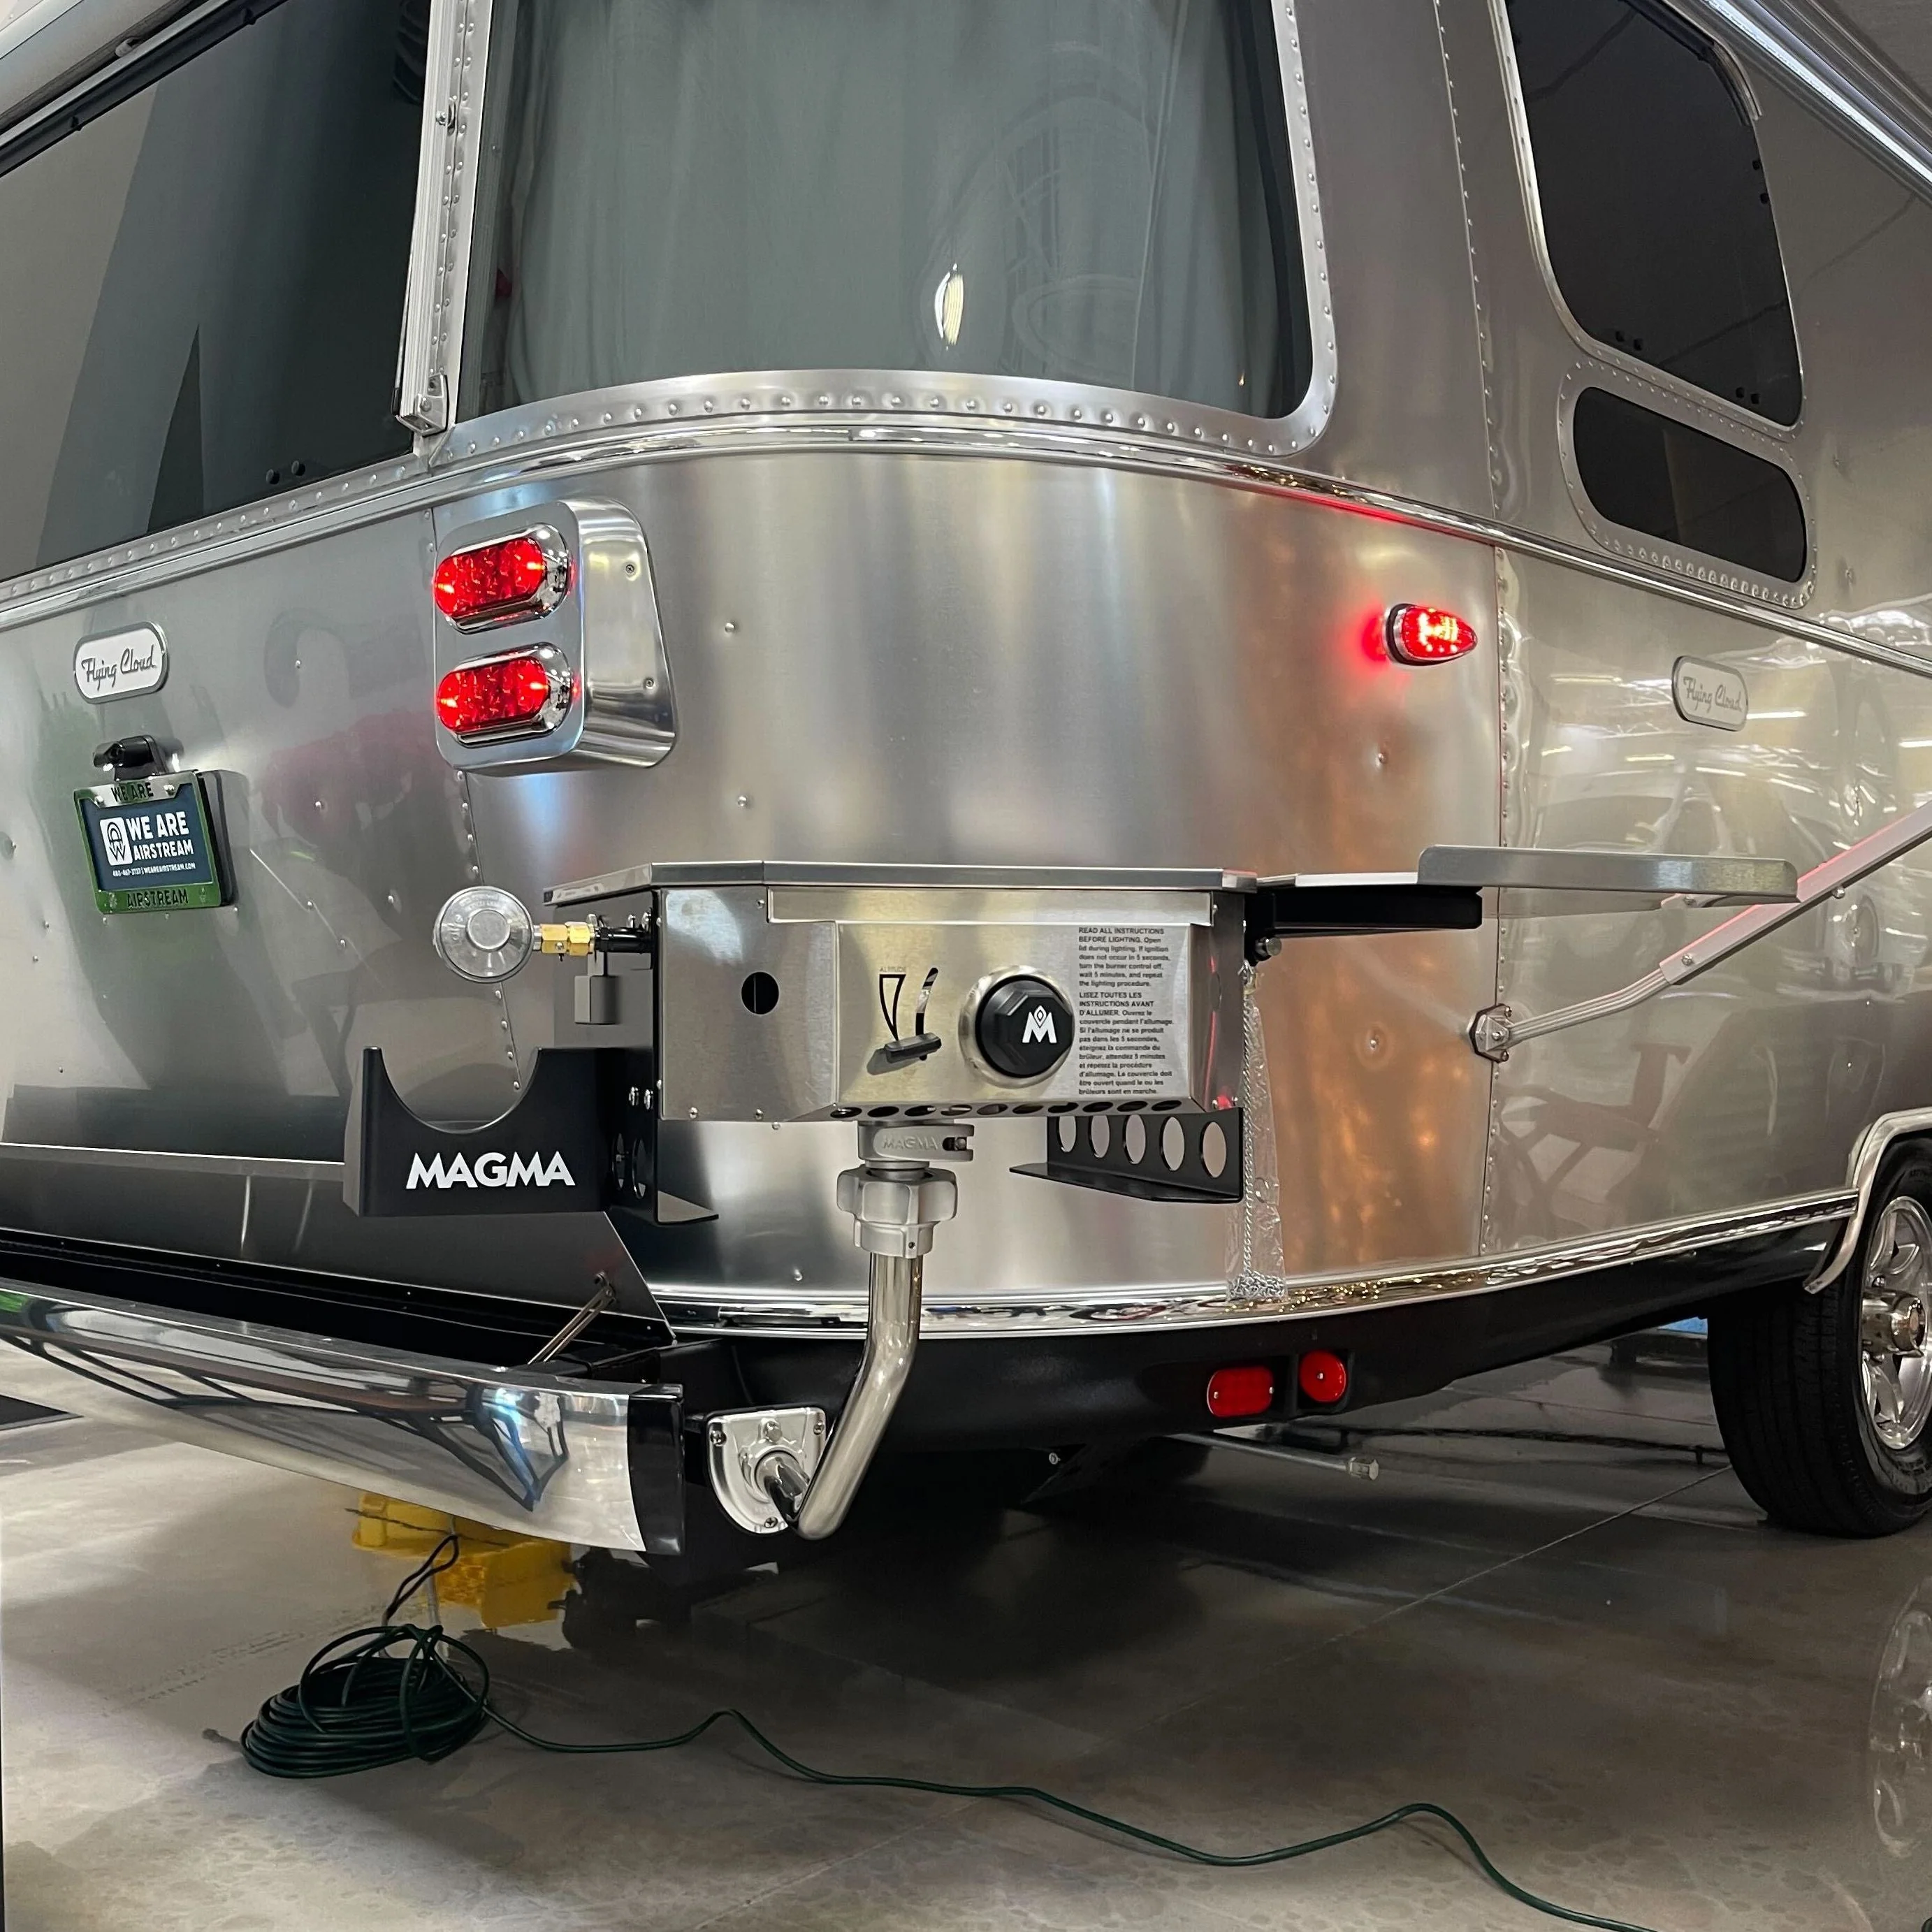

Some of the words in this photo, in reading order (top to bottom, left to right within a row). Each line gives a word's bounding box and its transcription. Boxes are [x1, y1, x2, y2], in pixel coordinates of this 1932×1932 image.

[81, 658, 117, 692] Flying
[120, 644, 157, 674] Cloud
[1683, 676, 1713, 713] Flying
[1715, 684, 1743, 712] Cloud
[111, 785, 128, 803] WE
[131, 782, 154, 799] ARE
[126, 815, 153, 841] WE
[156, 811, 189, 837] ARE
[133, 839, 194, 861] AIRSTREAM
[127, 888, 189, 908] AIRSTREAM
[883, 1135, 939, 1149] MAGMA
[406, 1151, 576, 1189] MAGMA
